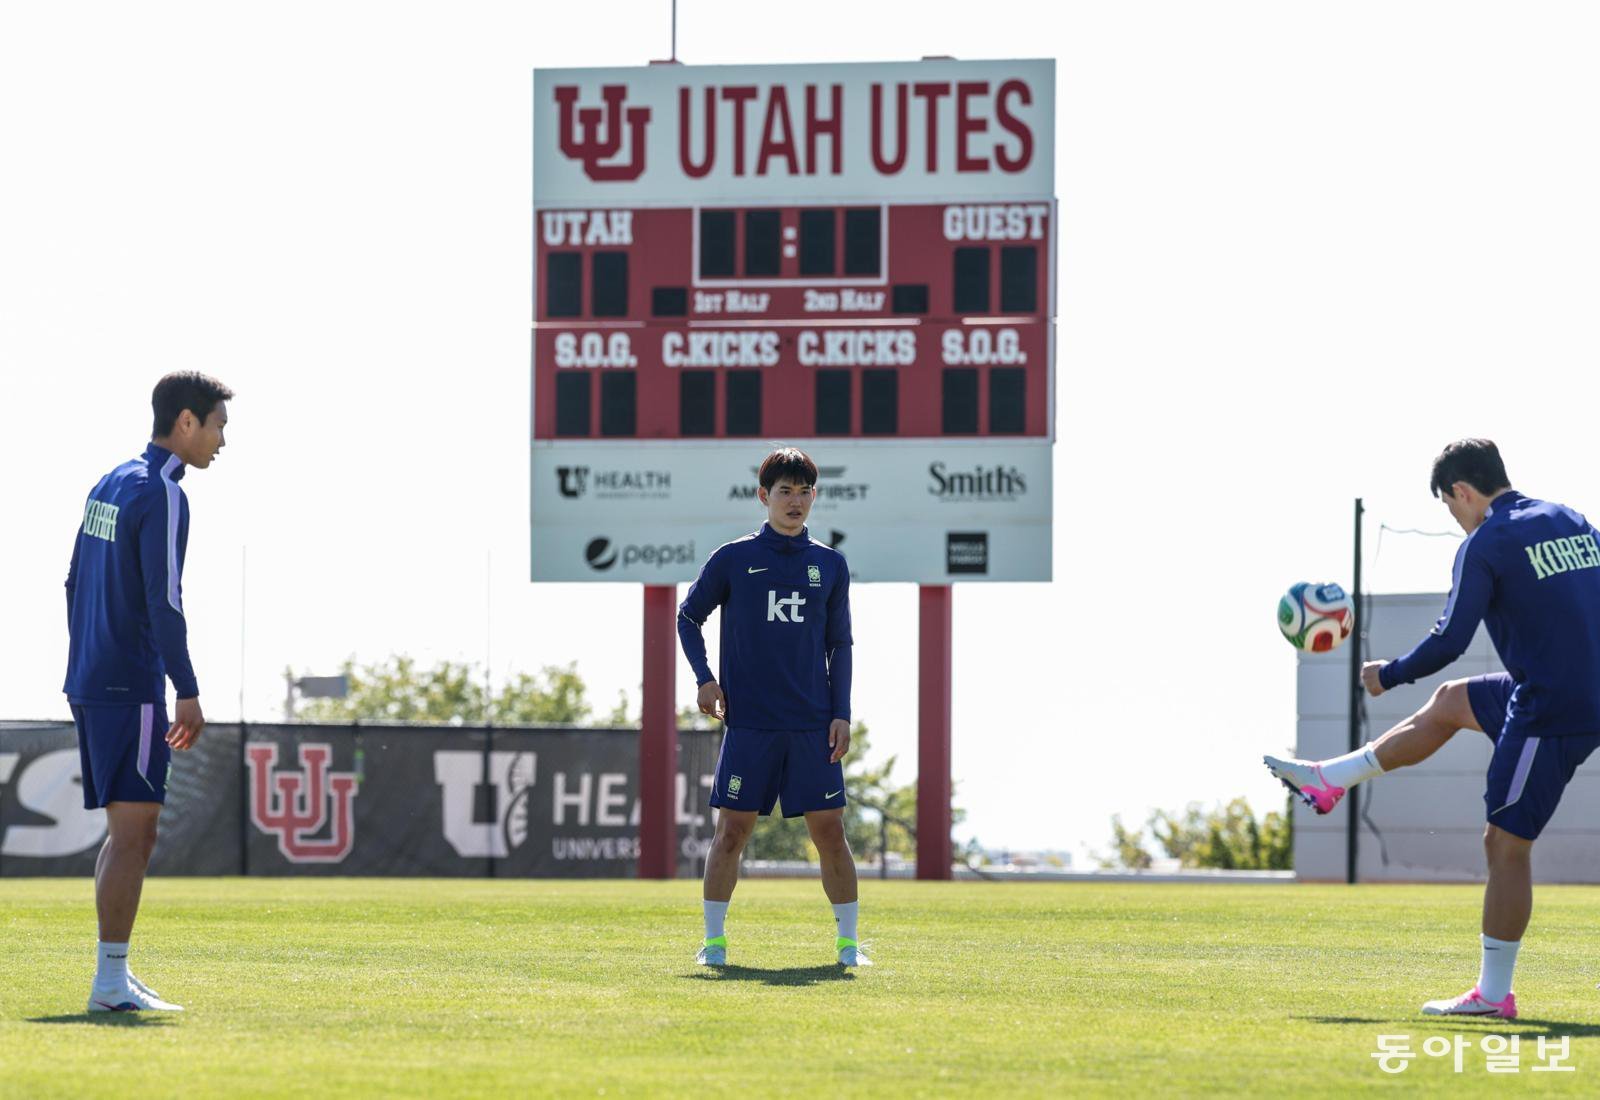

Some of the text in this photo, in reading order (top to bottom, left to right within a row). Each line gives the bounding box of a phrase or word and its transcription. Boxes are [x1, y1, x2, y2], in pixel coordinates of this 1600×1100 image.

[679, 78, 1035, 179] UTAH UTES
[543, 211, 633, 246] UTAH
[944, 205, 1048, 240] GUEST
[555, 332, 638, 367] S.O.G.
[662, 331, 780, 367] C.KICKS
[798, 330, 917, 366] C.KICKS
[942, 329, 1028, 364] S.O.G.
[595, 471, 671, 489] HEALTH
[928, 461, 1027, 496] Smith's
[623, 541, 695, 568] pepsi
[1525, 534, 1600, 580] KOREA
[767, 590, 806, 623] kt
